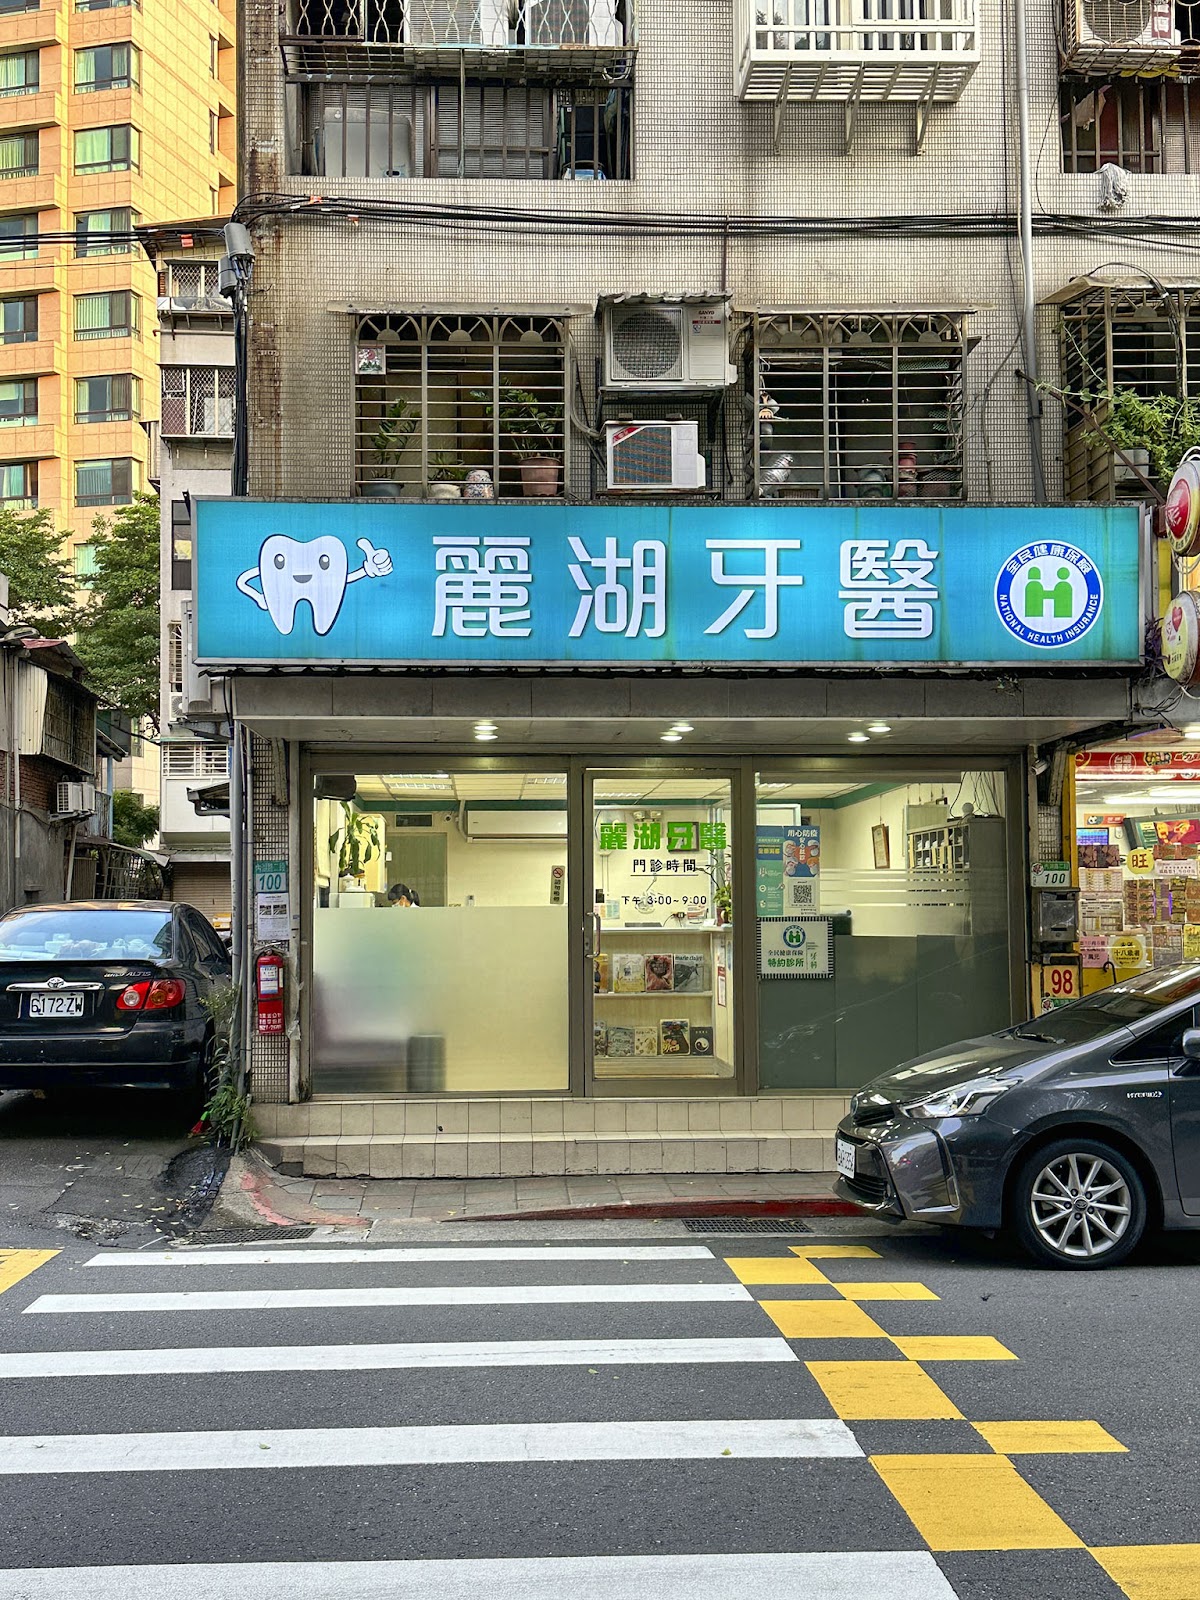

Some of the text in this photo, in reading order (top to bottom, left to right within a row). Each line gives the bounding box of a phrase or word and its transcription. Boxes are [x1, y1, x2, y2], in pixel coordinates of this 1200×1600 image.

[1006, 543, 1093, 576] 全民健康保險
[432, 536, 939, 639] 麗湖牙醫
[999, 593, 1099, 644] NATIONAL HEALTH INSURANCE
[600, 821, 727, 850] 麗湖牙醫
[633, 859, 697, 873] 門診時間
[1131, 853, 1149, 869] 旺
[259, 873, 282, 891] 100
[1045, 873, 1066, 884] 100
[621, 895, 641, 905] 下午
[768, 957, 805, 968] 特約診所
[1051, 969, 1073, 995] 98
